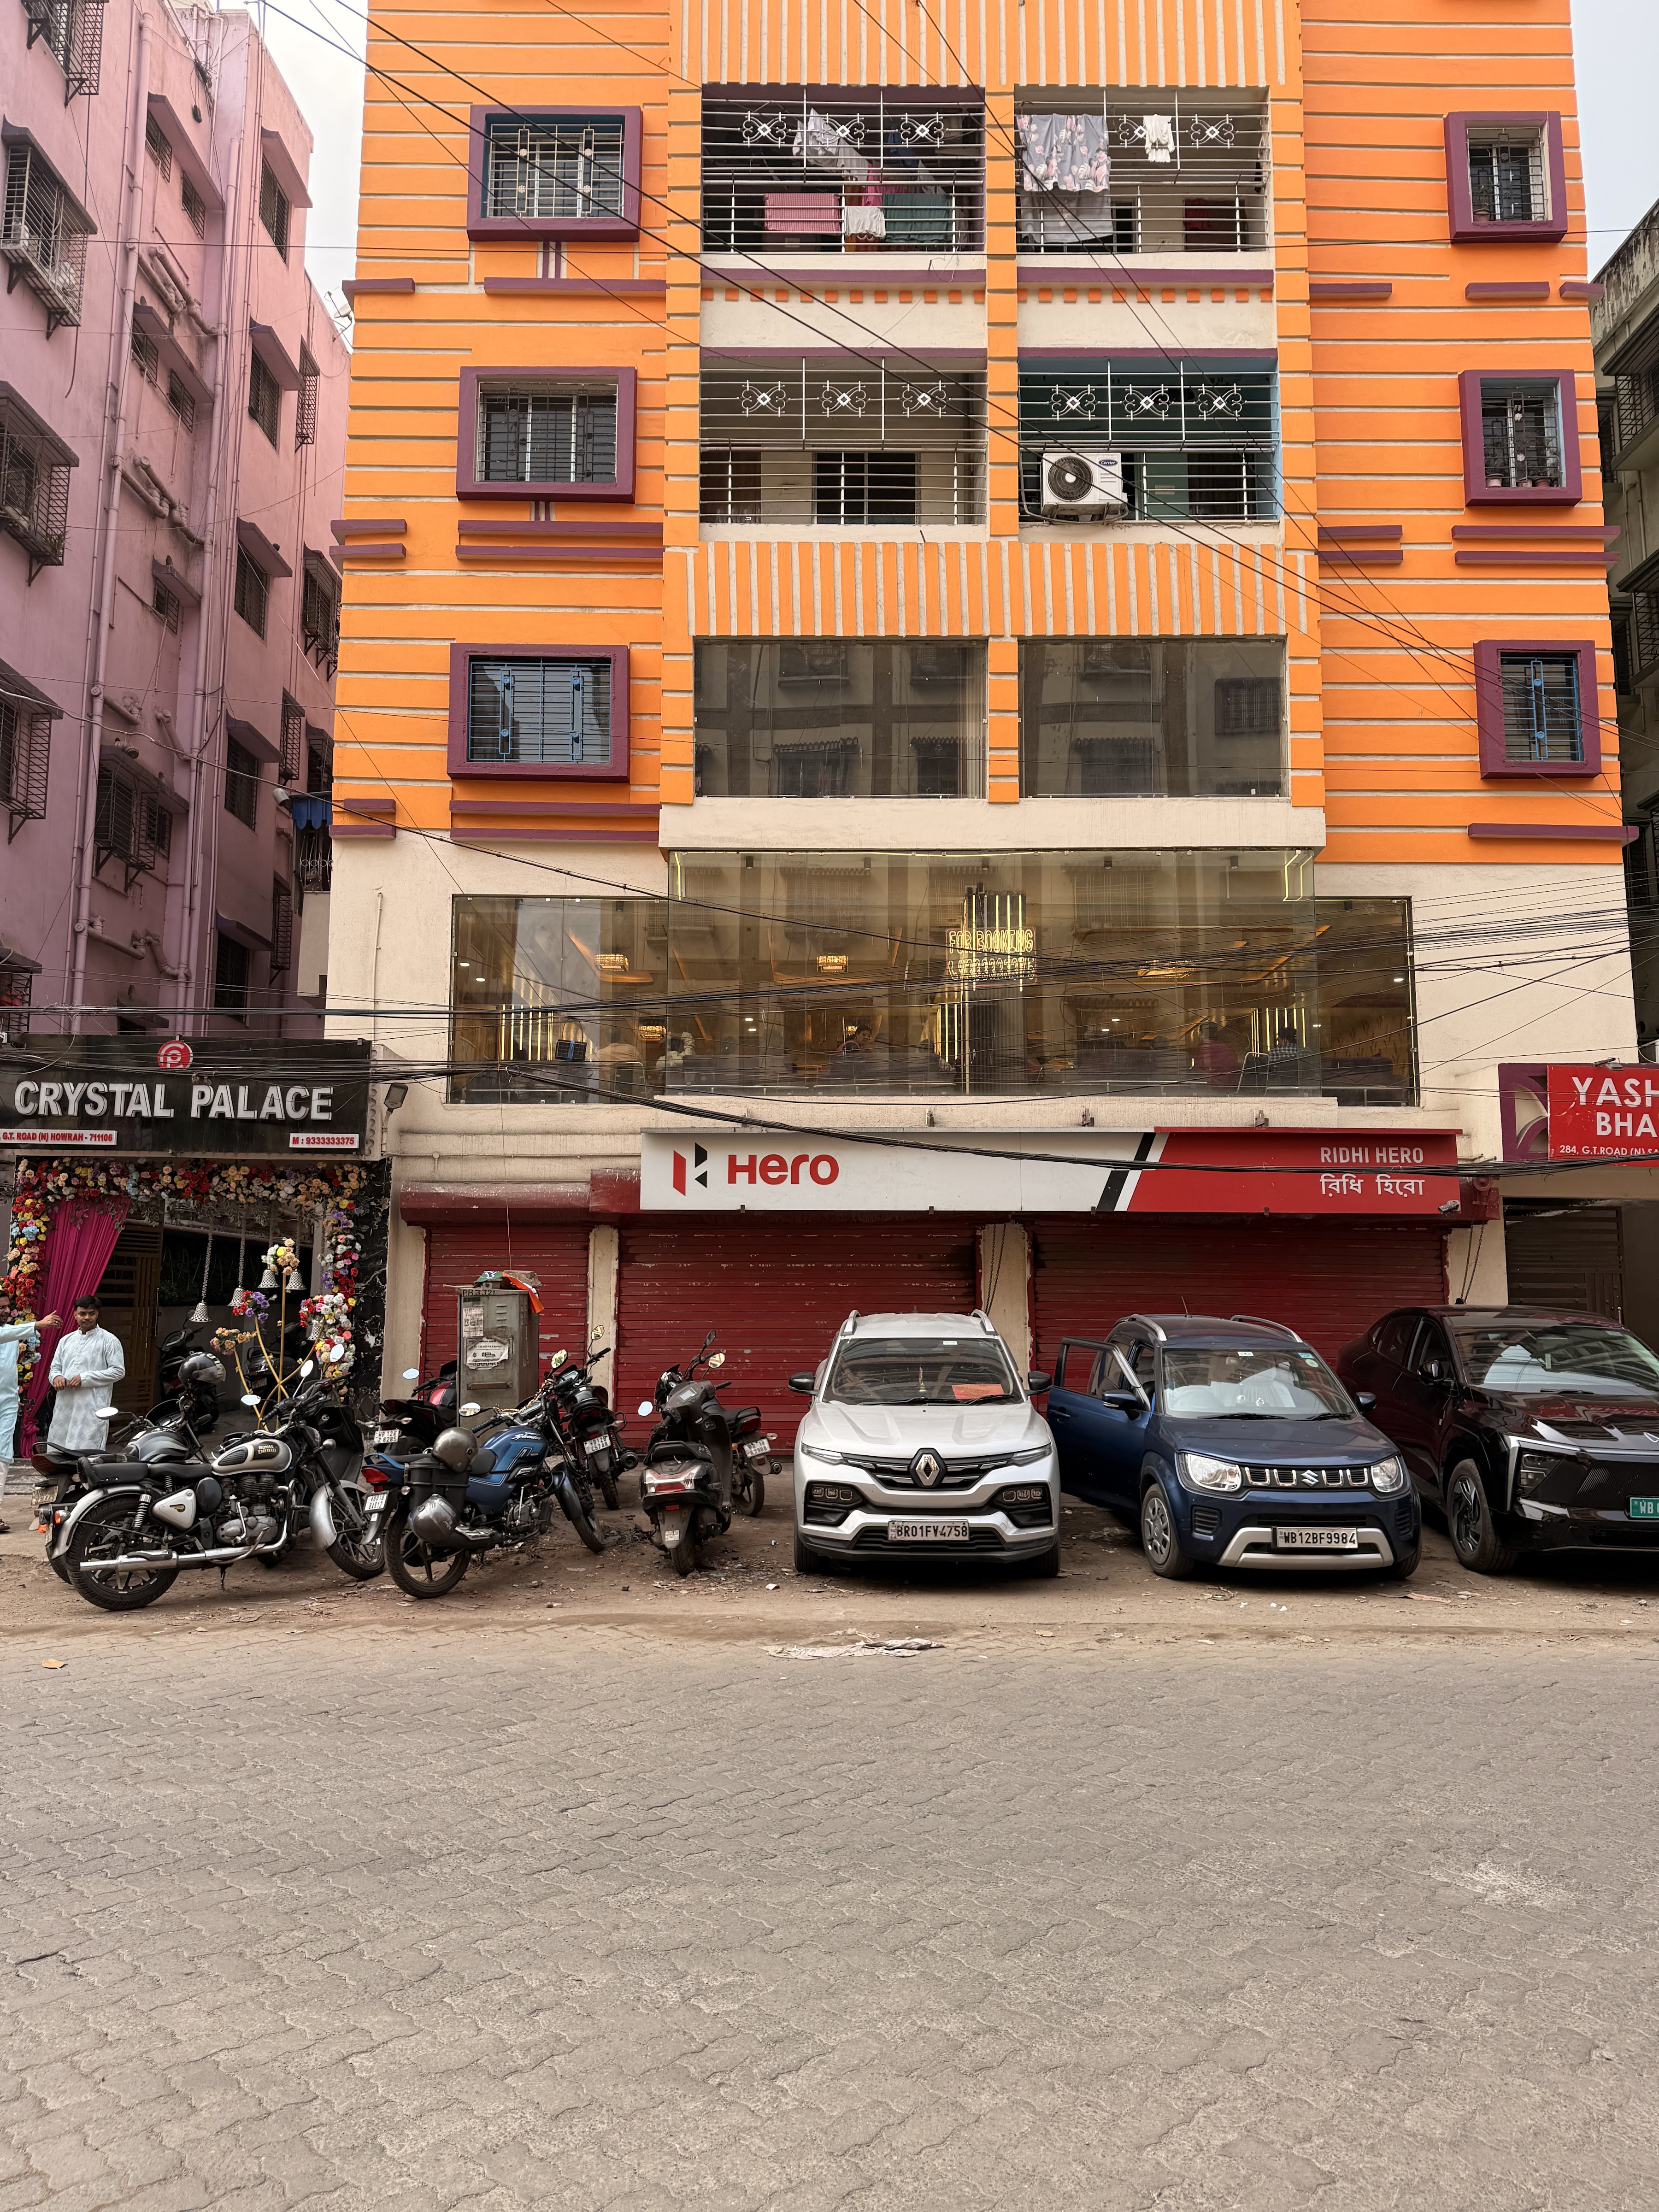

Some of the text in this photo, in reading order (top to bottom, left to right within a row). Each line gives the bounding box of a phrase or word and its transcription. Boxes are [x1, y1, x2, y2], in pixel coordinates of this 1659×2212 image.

[949, 929, 1033, 954] FOR BOOKING
[14, 1081, 333, 1121] CRYSTAL PALACE
[1572, 1077, 1659, 1108] YASH
[1596, 1112, 1659, 1138] BHA
[39, 1132, 48, 1141] (N)
[50, 1133, 83, 1141] HOWRAH
[1320, 1147, 1424, 1164] RIDHI HERO
[1559, 1145, 1578, 1155] 284,
[1582, 1146, 1627, 1155] G.T.ROAD
[1320, 1173, 1425, 1198] রিধি হিরো
[897, 1525, 967, 1537] BR01FV4758
[1283, 1531, 1356, 1544] WB12BF9984
